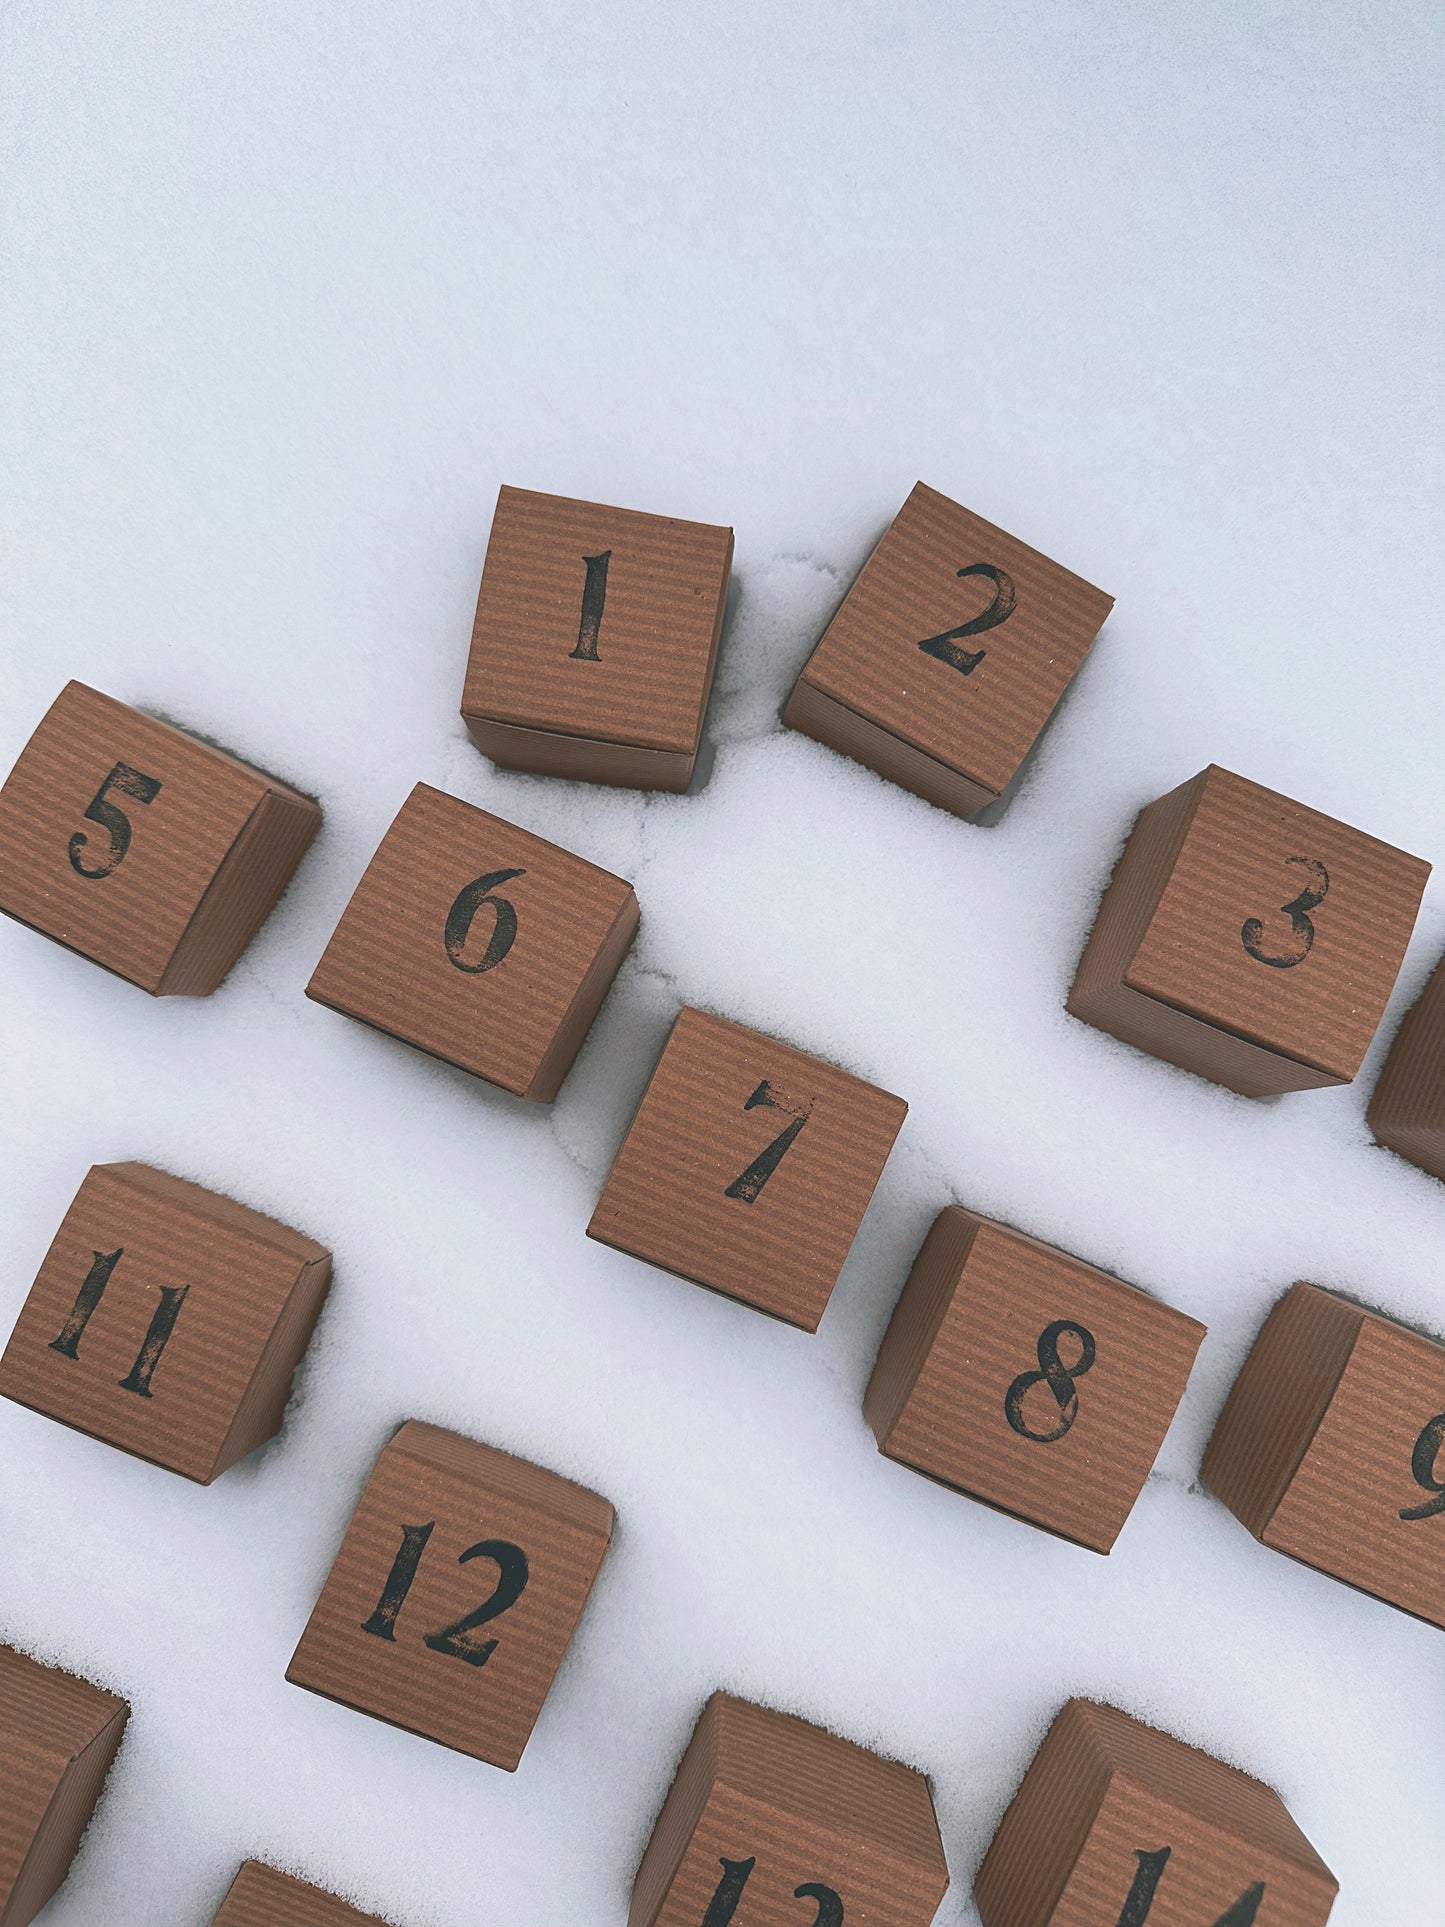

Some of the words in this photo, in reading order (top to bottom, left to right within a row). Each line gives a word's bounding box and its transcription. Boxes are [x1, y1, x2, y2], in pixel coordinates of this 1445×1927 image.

[569, 549, 611, 662] 1
[918, 563, 1017, 676] 2
[69, 761, 162, 879] 5
[445, 869, 526, 973] 6
[1241, 856, 1330, 968] 3
[724, 1080, 814, 1204] 7
[49, 1247, 190, 1398] 11
[1005, 1320, 1095, 1442] 8
[361, 1521, 529, 1667] 12
